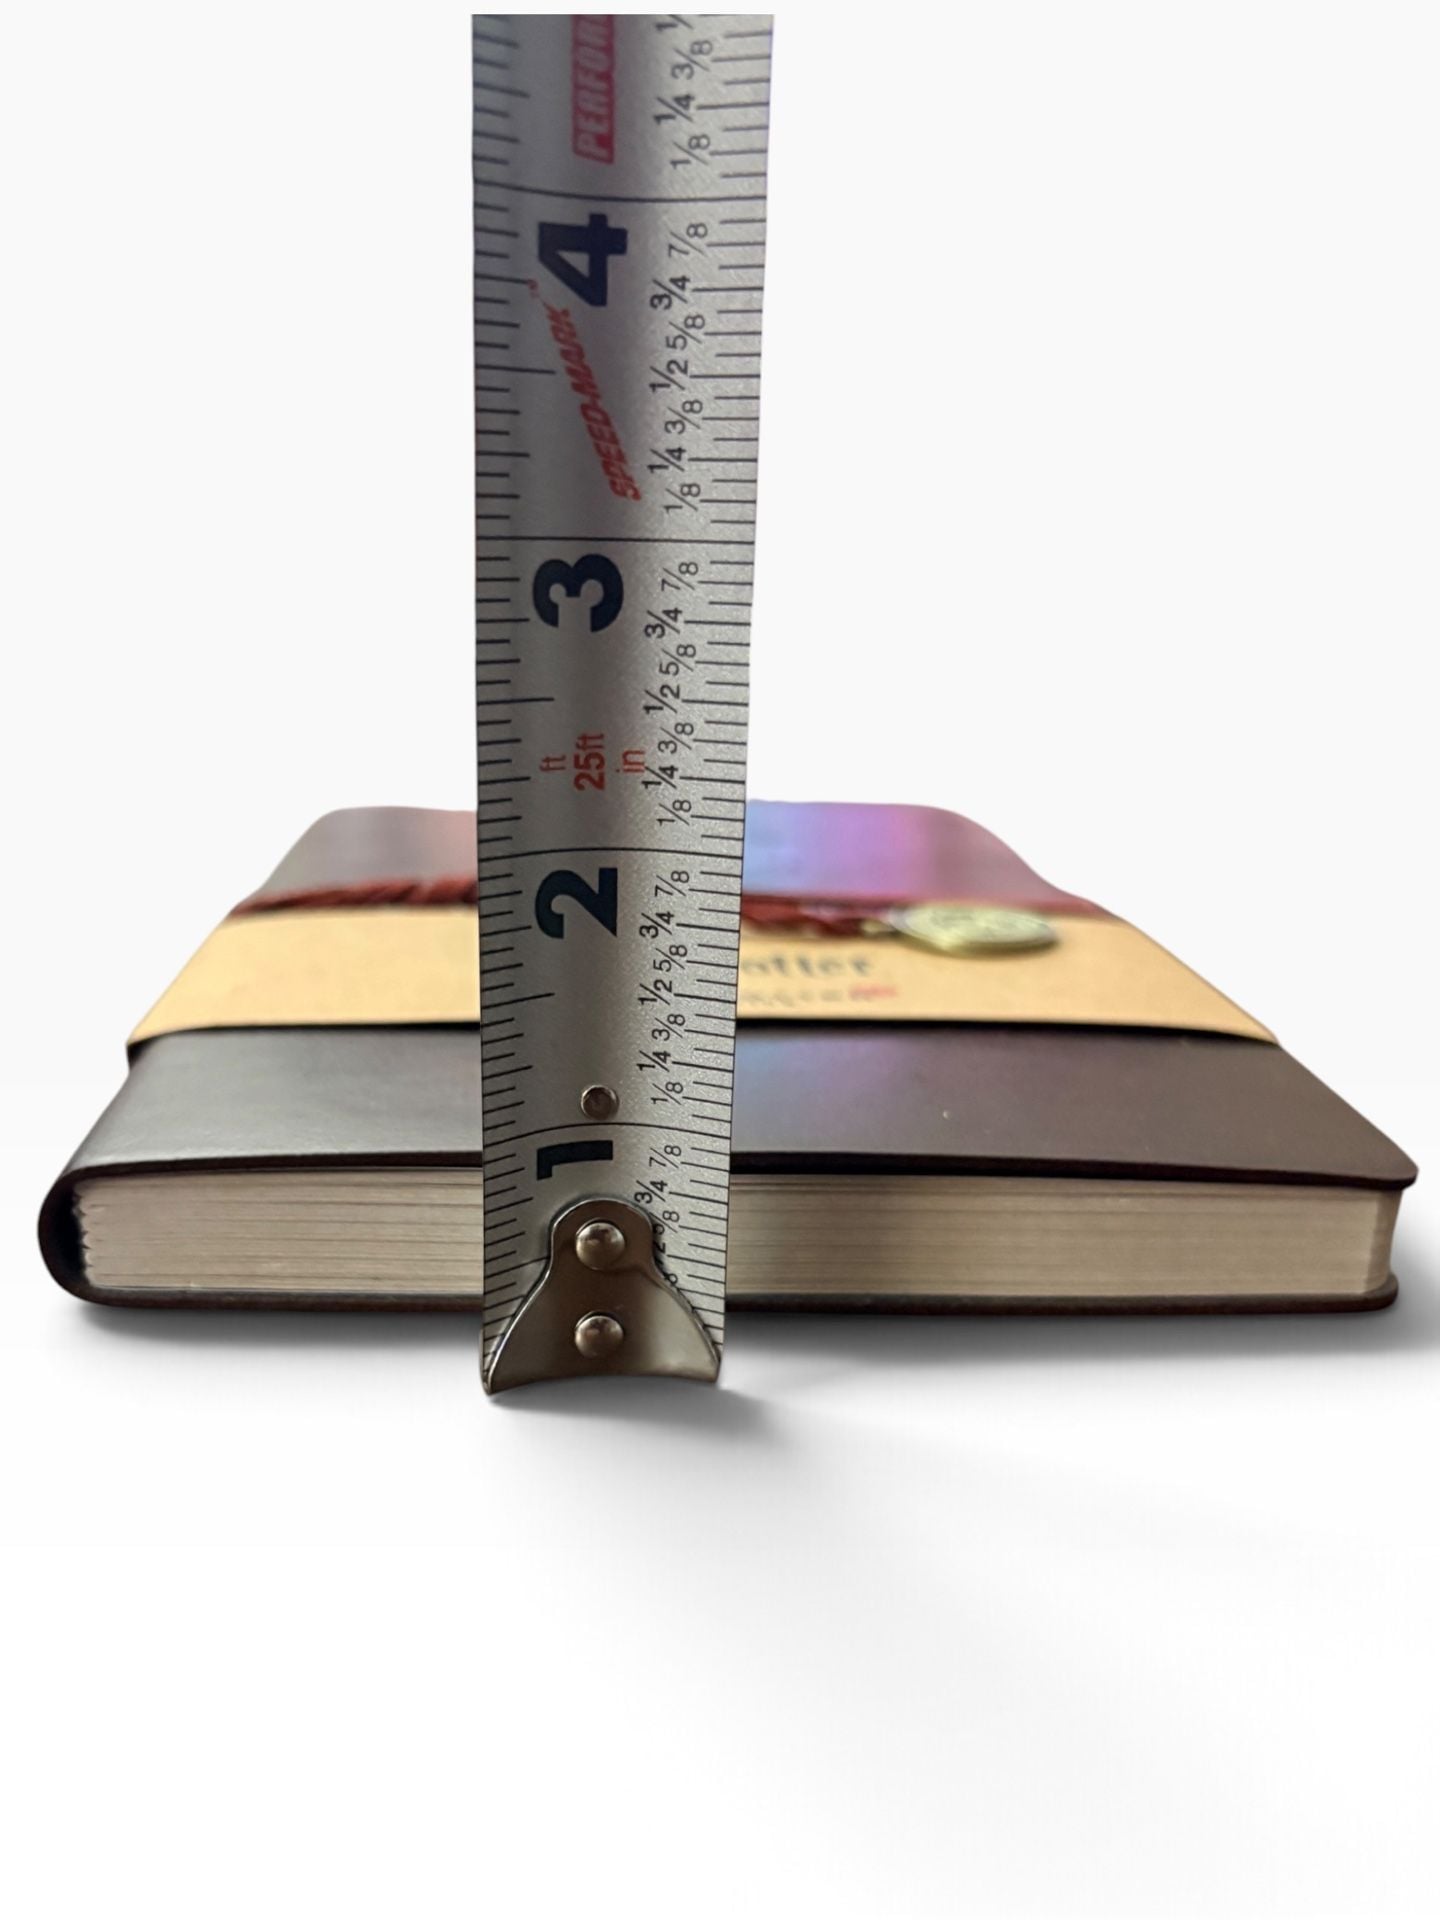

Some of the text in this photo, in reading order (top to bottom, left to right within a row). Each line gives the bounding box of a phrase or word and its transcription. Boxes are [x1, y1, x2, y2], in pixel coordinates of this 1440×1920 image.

[671, 39, 714, 80] 3/8
[573, 14, 613, 161] PERFOR
[653, 93, 695, 125] 1/4
[670, 133, 711, 170] 1/8
[668, 222, 709, 258] 7/8
[538, 213, 628, 307] 4
[650, 275, 691, 310] 3/4
[665, 313, 705, 351] 5/8
[648, 359, 688, 392] 1/2
[546, 301, 642, 501] SPEED-MARK
[665, 398, 704, 434] 3/8
[647, 446, 686, 473] 1/4
[663, 482, 702, 513] 1/8
[661, 561, 699, 591] 7/8
[532, 553, 624, 633] 3
[645, 607, 683, 639] 3/4
[659, 643, 696, 675] 5/8
[643, 683, 681, 714] 1/2
[658, 721, 695, 754] 3/8
[539, 754, 567, 772] ft
[573, 733, 605, 791] 25ft
[615, 750, 645, 774] in
[641, 765, 679, 789] 1/4
[656, 799, 692, 826] 1/8
[655, 870, 690, 897] 7/8
[534, 867, 618, 939] 2
[639, 911, 675, 939] 3/4
[653, 944, 688, 972] 5/8
[637, 979, 673, 1006] 1/2
[651, 1013, 686, 1041] 3/8
[636, 1050, 672, 1072] 1/4
[651, 1081, 684, 1105] 1/8
[536, 1140, 614, 1181] 1
[649, 1144, 682, 1169] 7/8
[634, 1179, 668, 1203] 3/4
